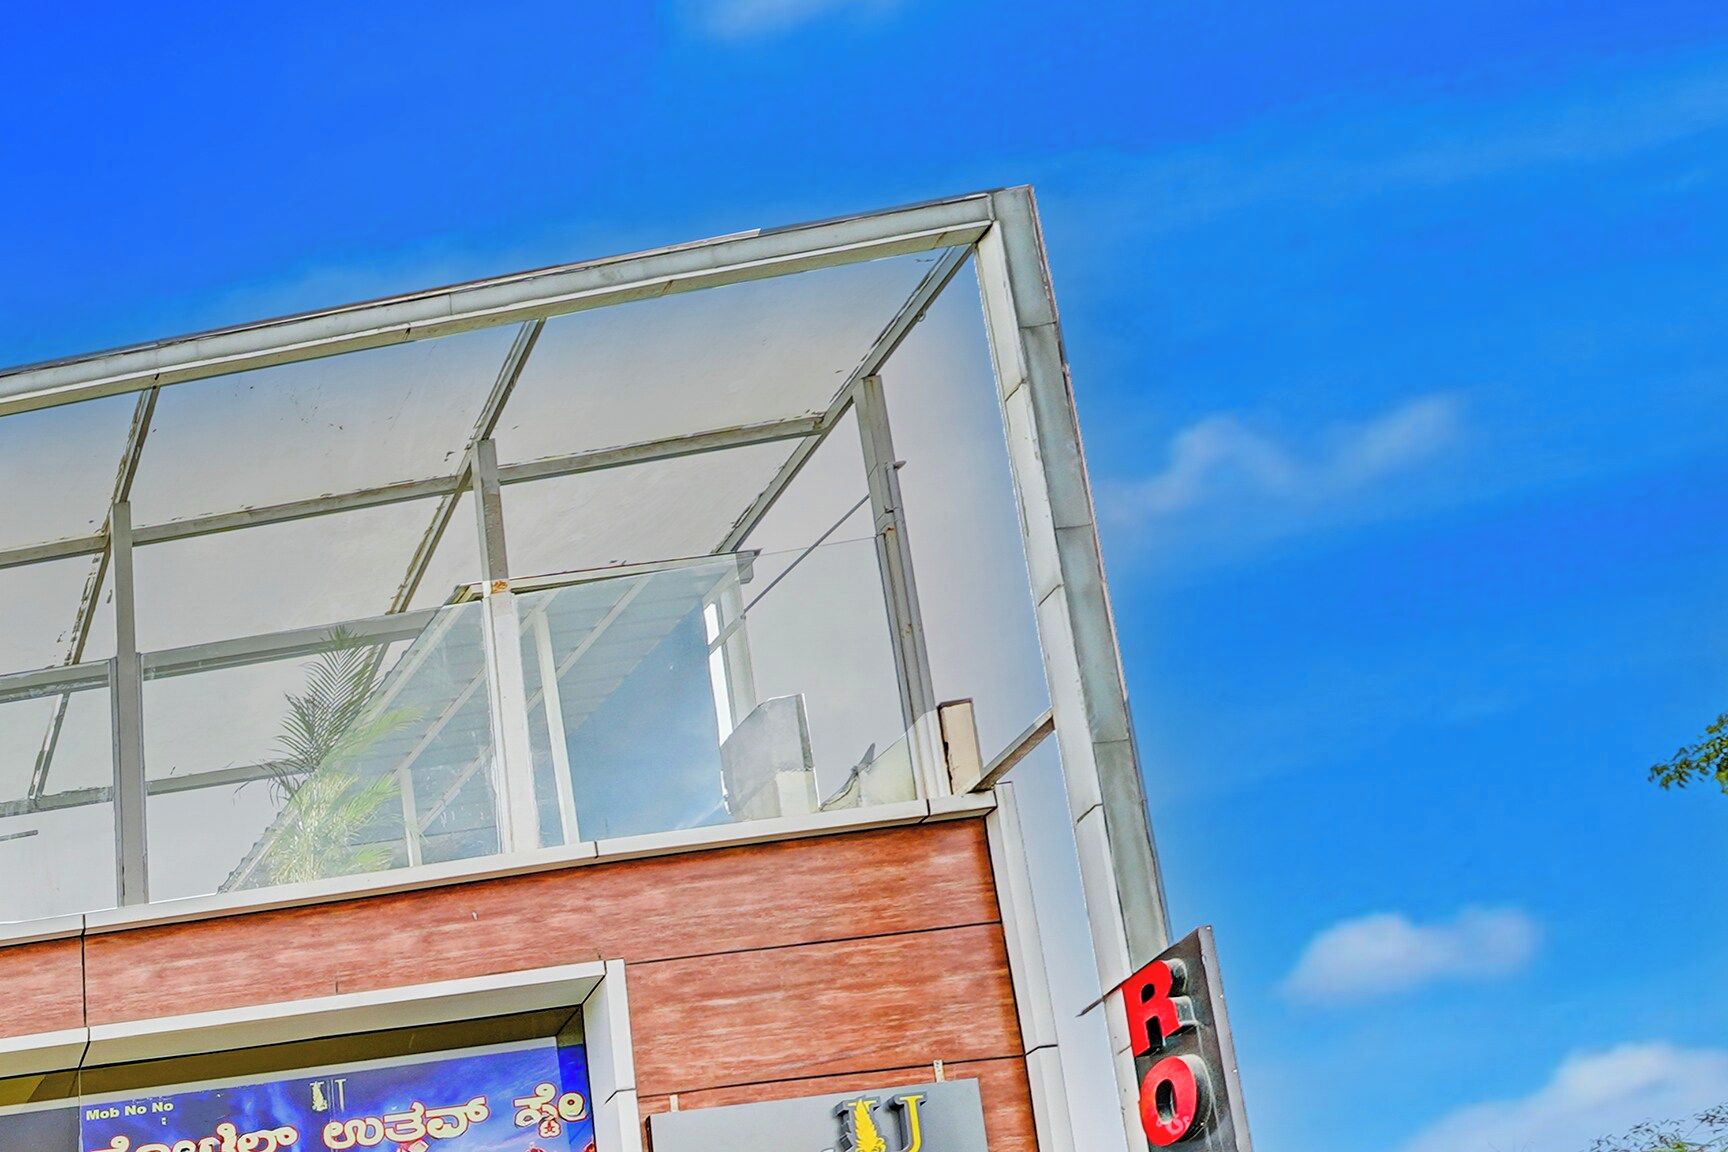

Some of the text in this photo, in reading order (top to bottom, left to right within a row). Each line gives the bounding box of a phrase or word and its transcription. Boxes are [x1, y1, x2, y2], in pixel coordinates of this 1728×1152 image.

[86, 1102, 174, 1121] Mob No No
